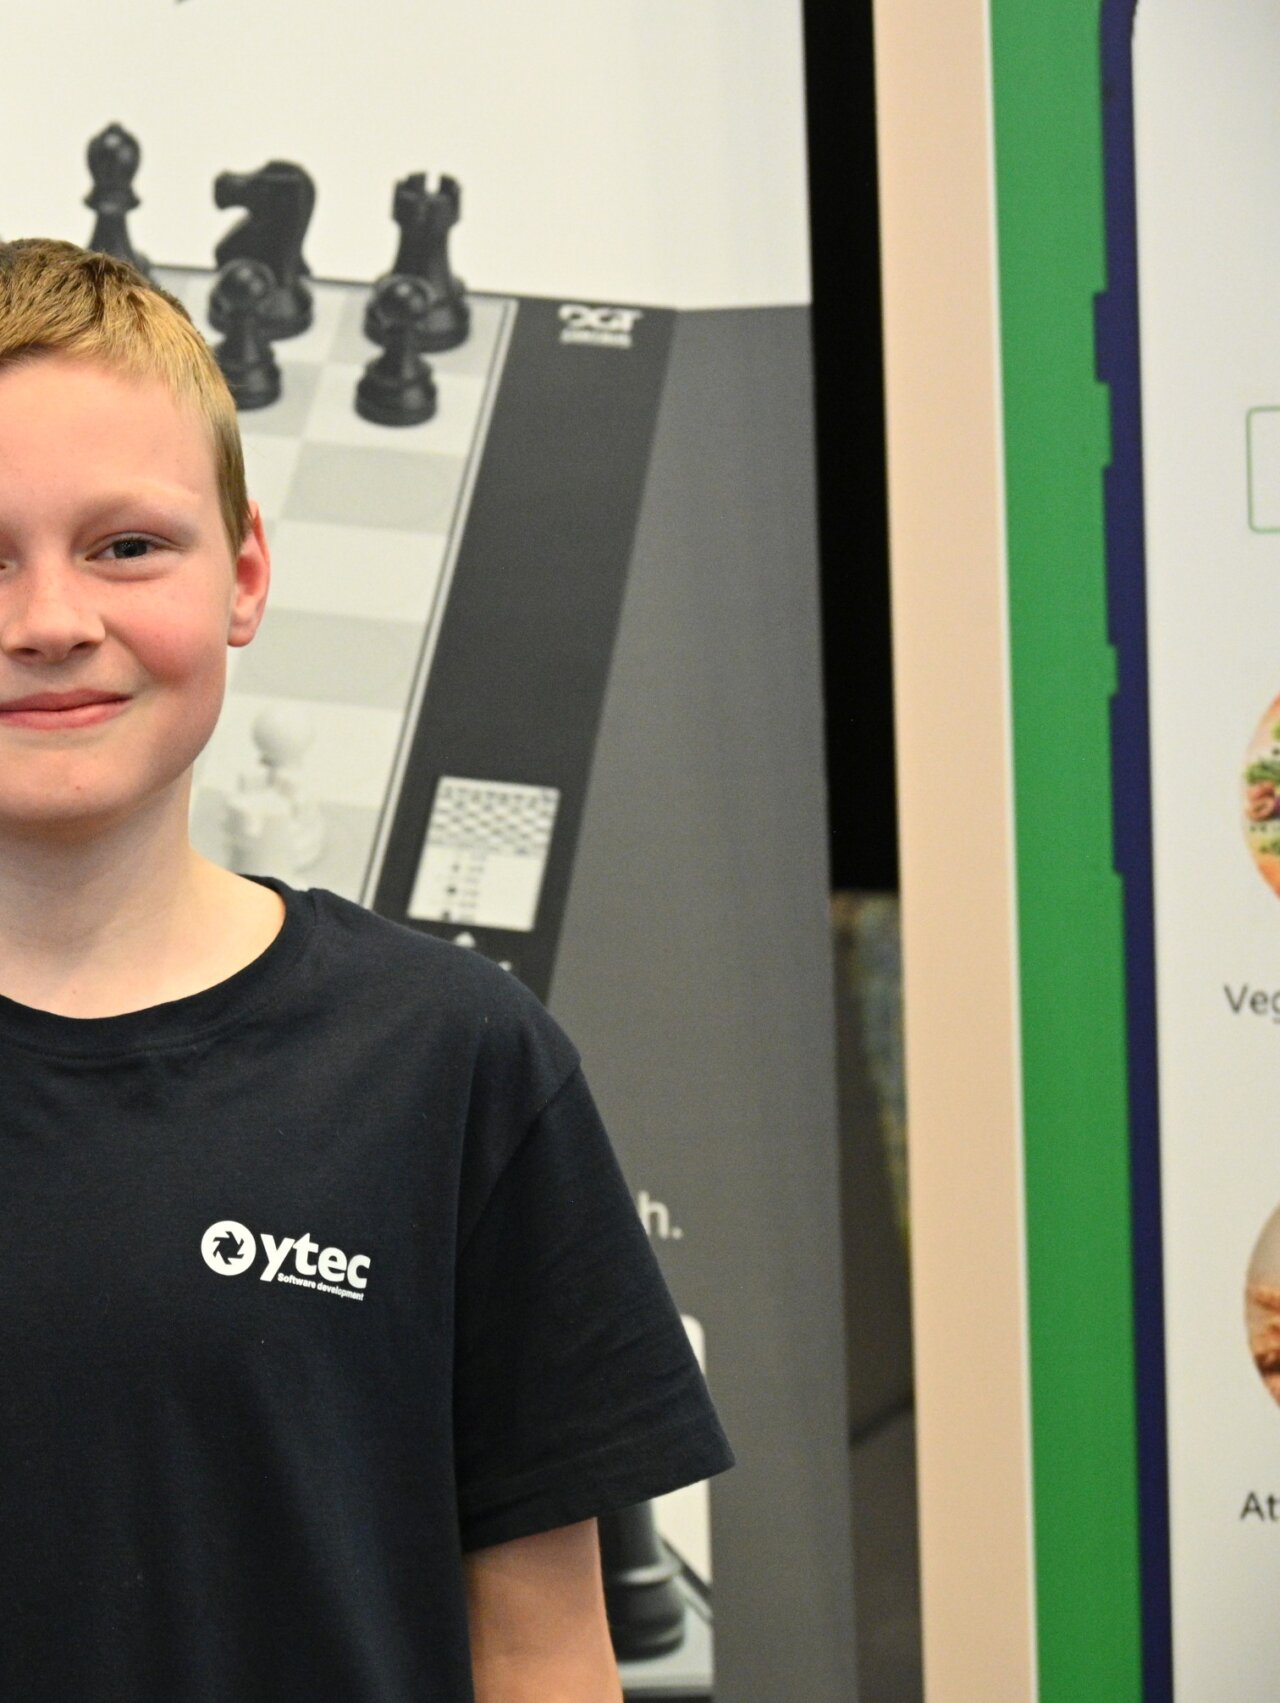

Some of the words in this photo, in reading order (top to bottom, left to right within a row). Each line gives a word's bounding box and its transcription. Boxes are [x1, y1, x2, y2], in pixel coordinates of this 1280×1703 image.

[260, 1232, 371, 1290] ytec
[277, 1272, 317, 1290] Software
[317, 1281, 365, 1302] development
